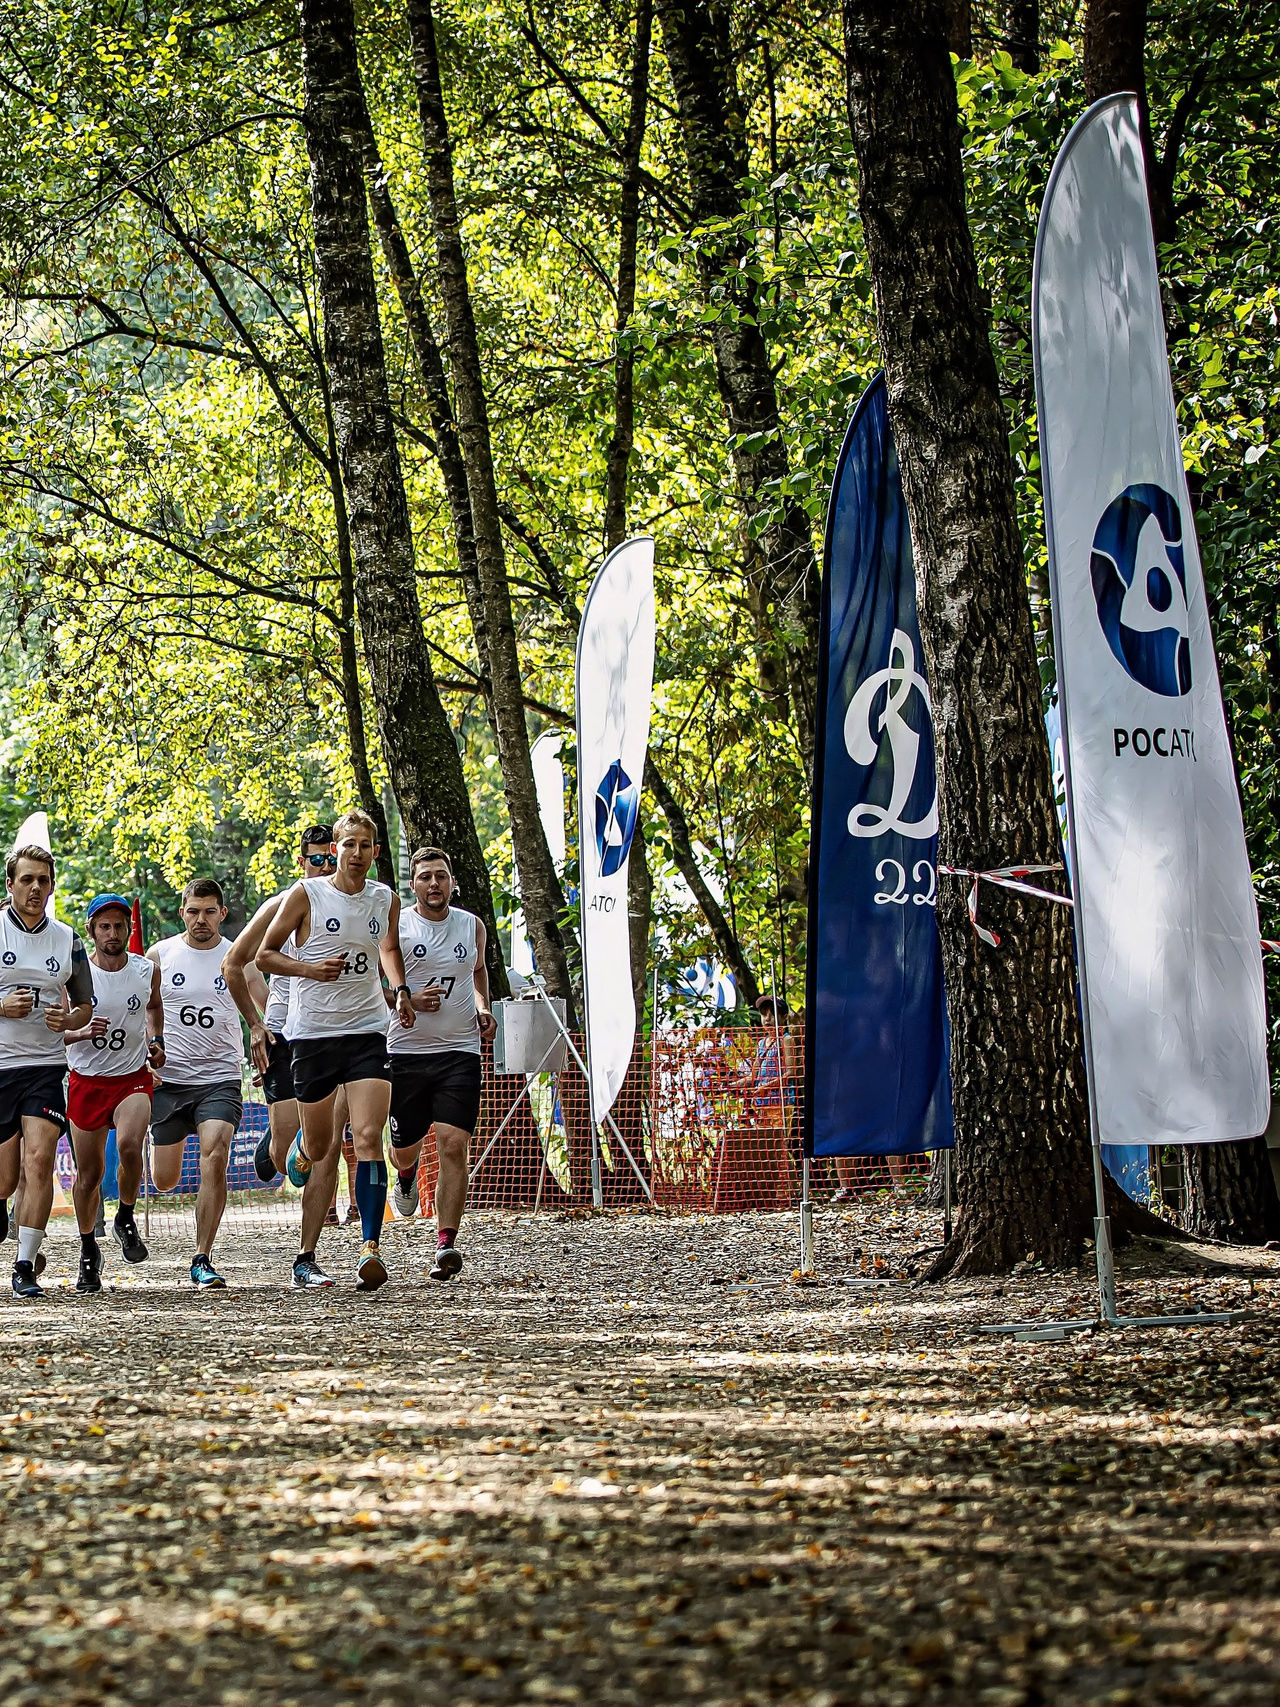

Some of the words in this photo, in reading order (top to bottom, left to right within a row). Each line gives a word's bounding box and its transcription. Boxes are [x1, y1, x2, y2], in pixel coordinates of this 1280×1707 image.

[873, 858, 937, 906] 22
[587, 895, 617, 913] АТО
[180, 1005, 215, 1029] 66
